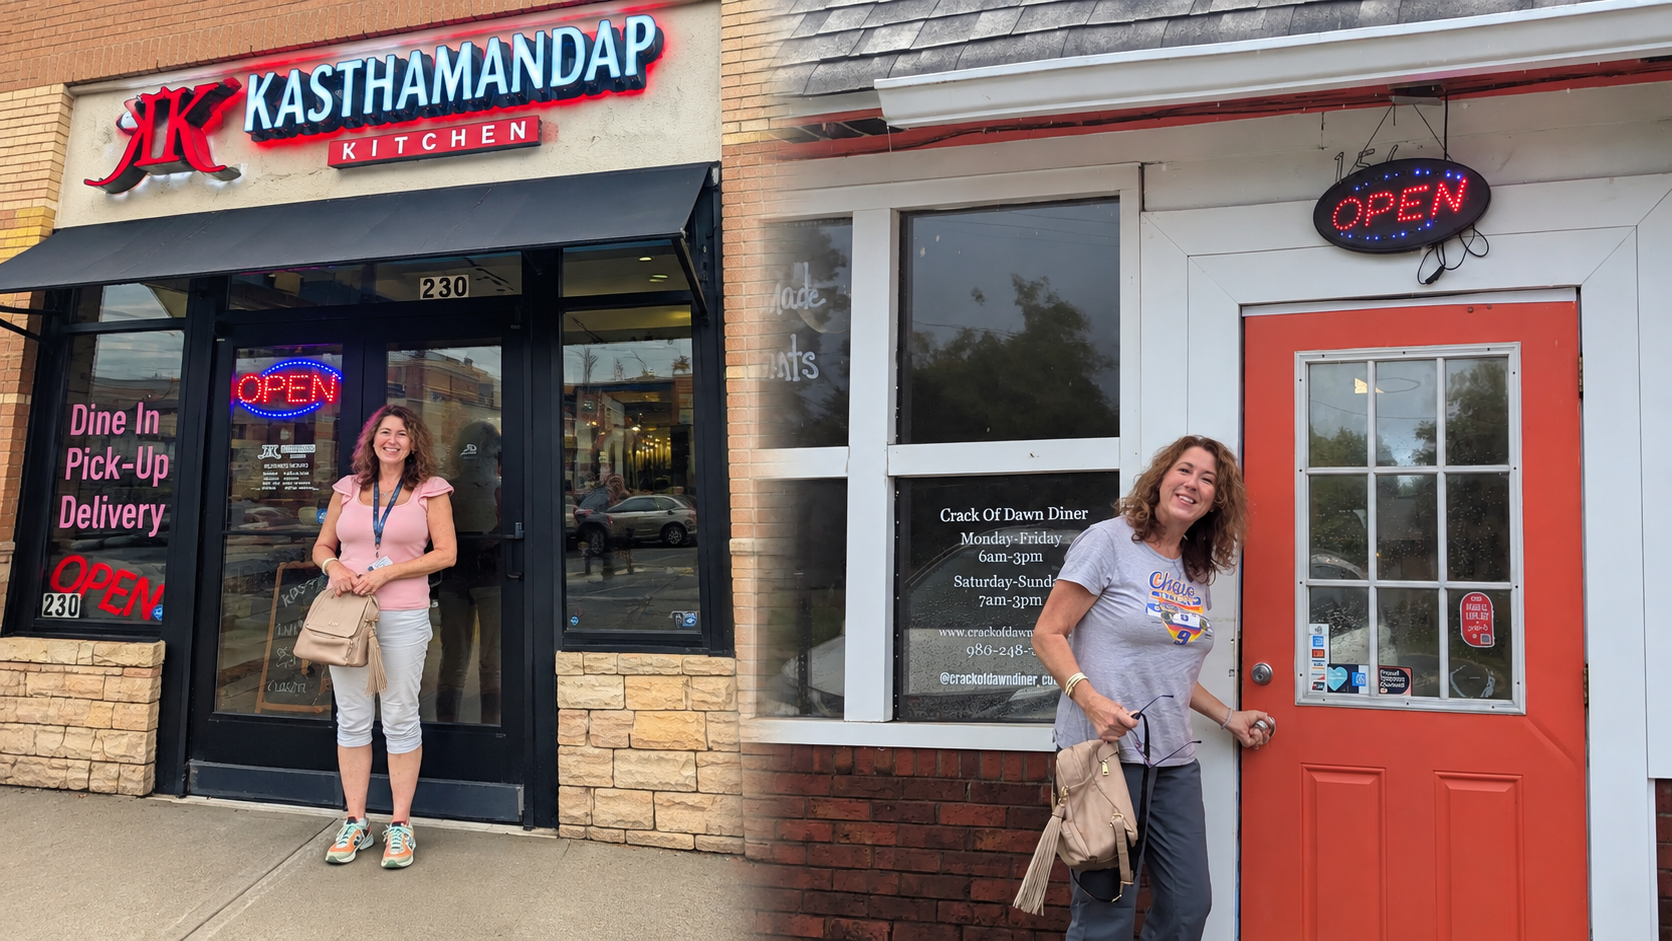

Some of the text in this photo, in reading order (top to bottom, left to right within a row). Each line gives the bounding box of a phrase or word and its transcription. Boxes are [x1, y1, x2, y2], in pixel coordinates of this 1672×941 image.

[243, 13, 657, 133] KASTHAMANDAP
[341, 120, 527, 161] KITCHEN
[1331, 177, 1468, 231] OPEN
[421, 276, 468, 299] 230
[236, 371, 338, 404] OPEN
[70, 401, 160, 436] Dine In
[65, 445, 170, 488] Pick-Up
[58, 495, 166, 538] Delivery
[940, 506, 1089, 523] Crack Of Dawn Diner
[960, 531, 1062, 548] Monday-Friday
[978, 549, 1044, 566] 6am-3pm
[50, 554, 166, 621] OPEN
[43, 594, 80, 617] 230
[978, 595, 1043, 610] 7am-3pm
[939, 626, 1035, 638] www.crackofdawn
[1174, 630, 1192, 646] 9
